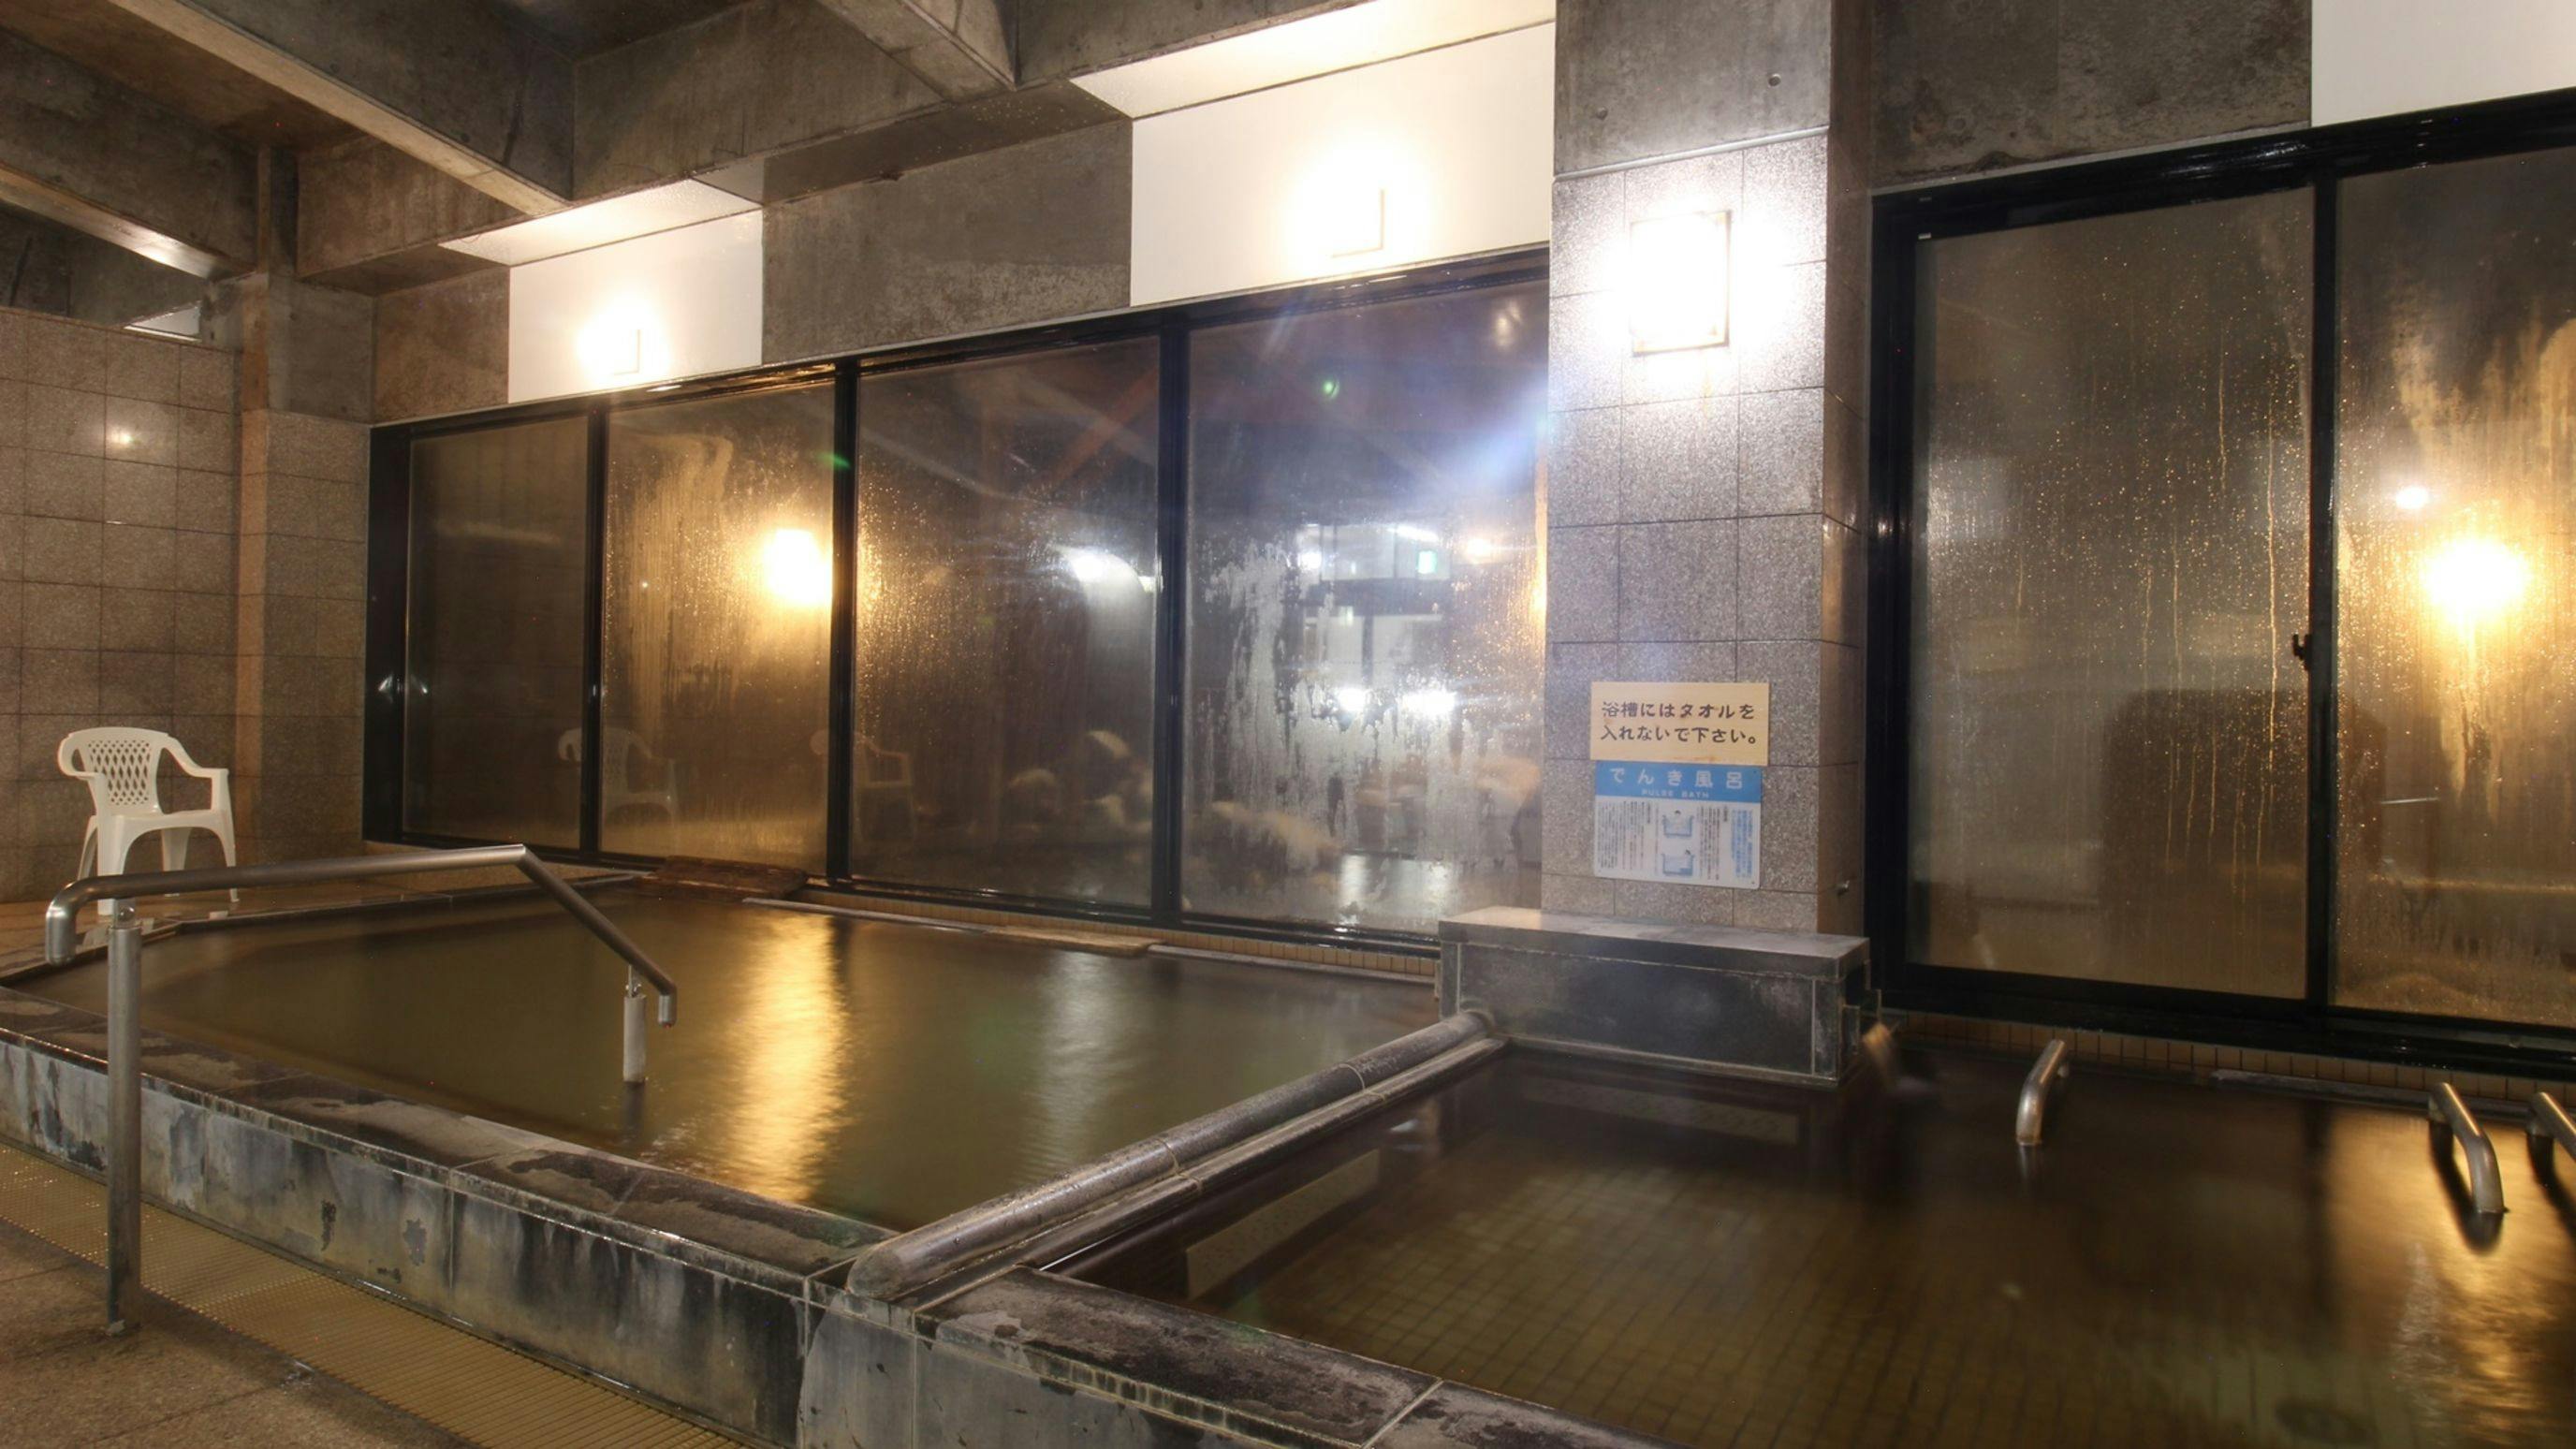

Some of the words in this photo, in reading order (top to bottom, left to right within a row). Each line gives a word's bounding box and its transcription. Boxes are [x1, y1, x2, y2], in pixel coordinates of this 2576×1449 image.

[1602, 701, 1755, 720] 浴槽にはタオルを
[1601, 724, 1756, 745] 入れないで下さい。
[1609, 768, 1743, 790] でんき風呂
